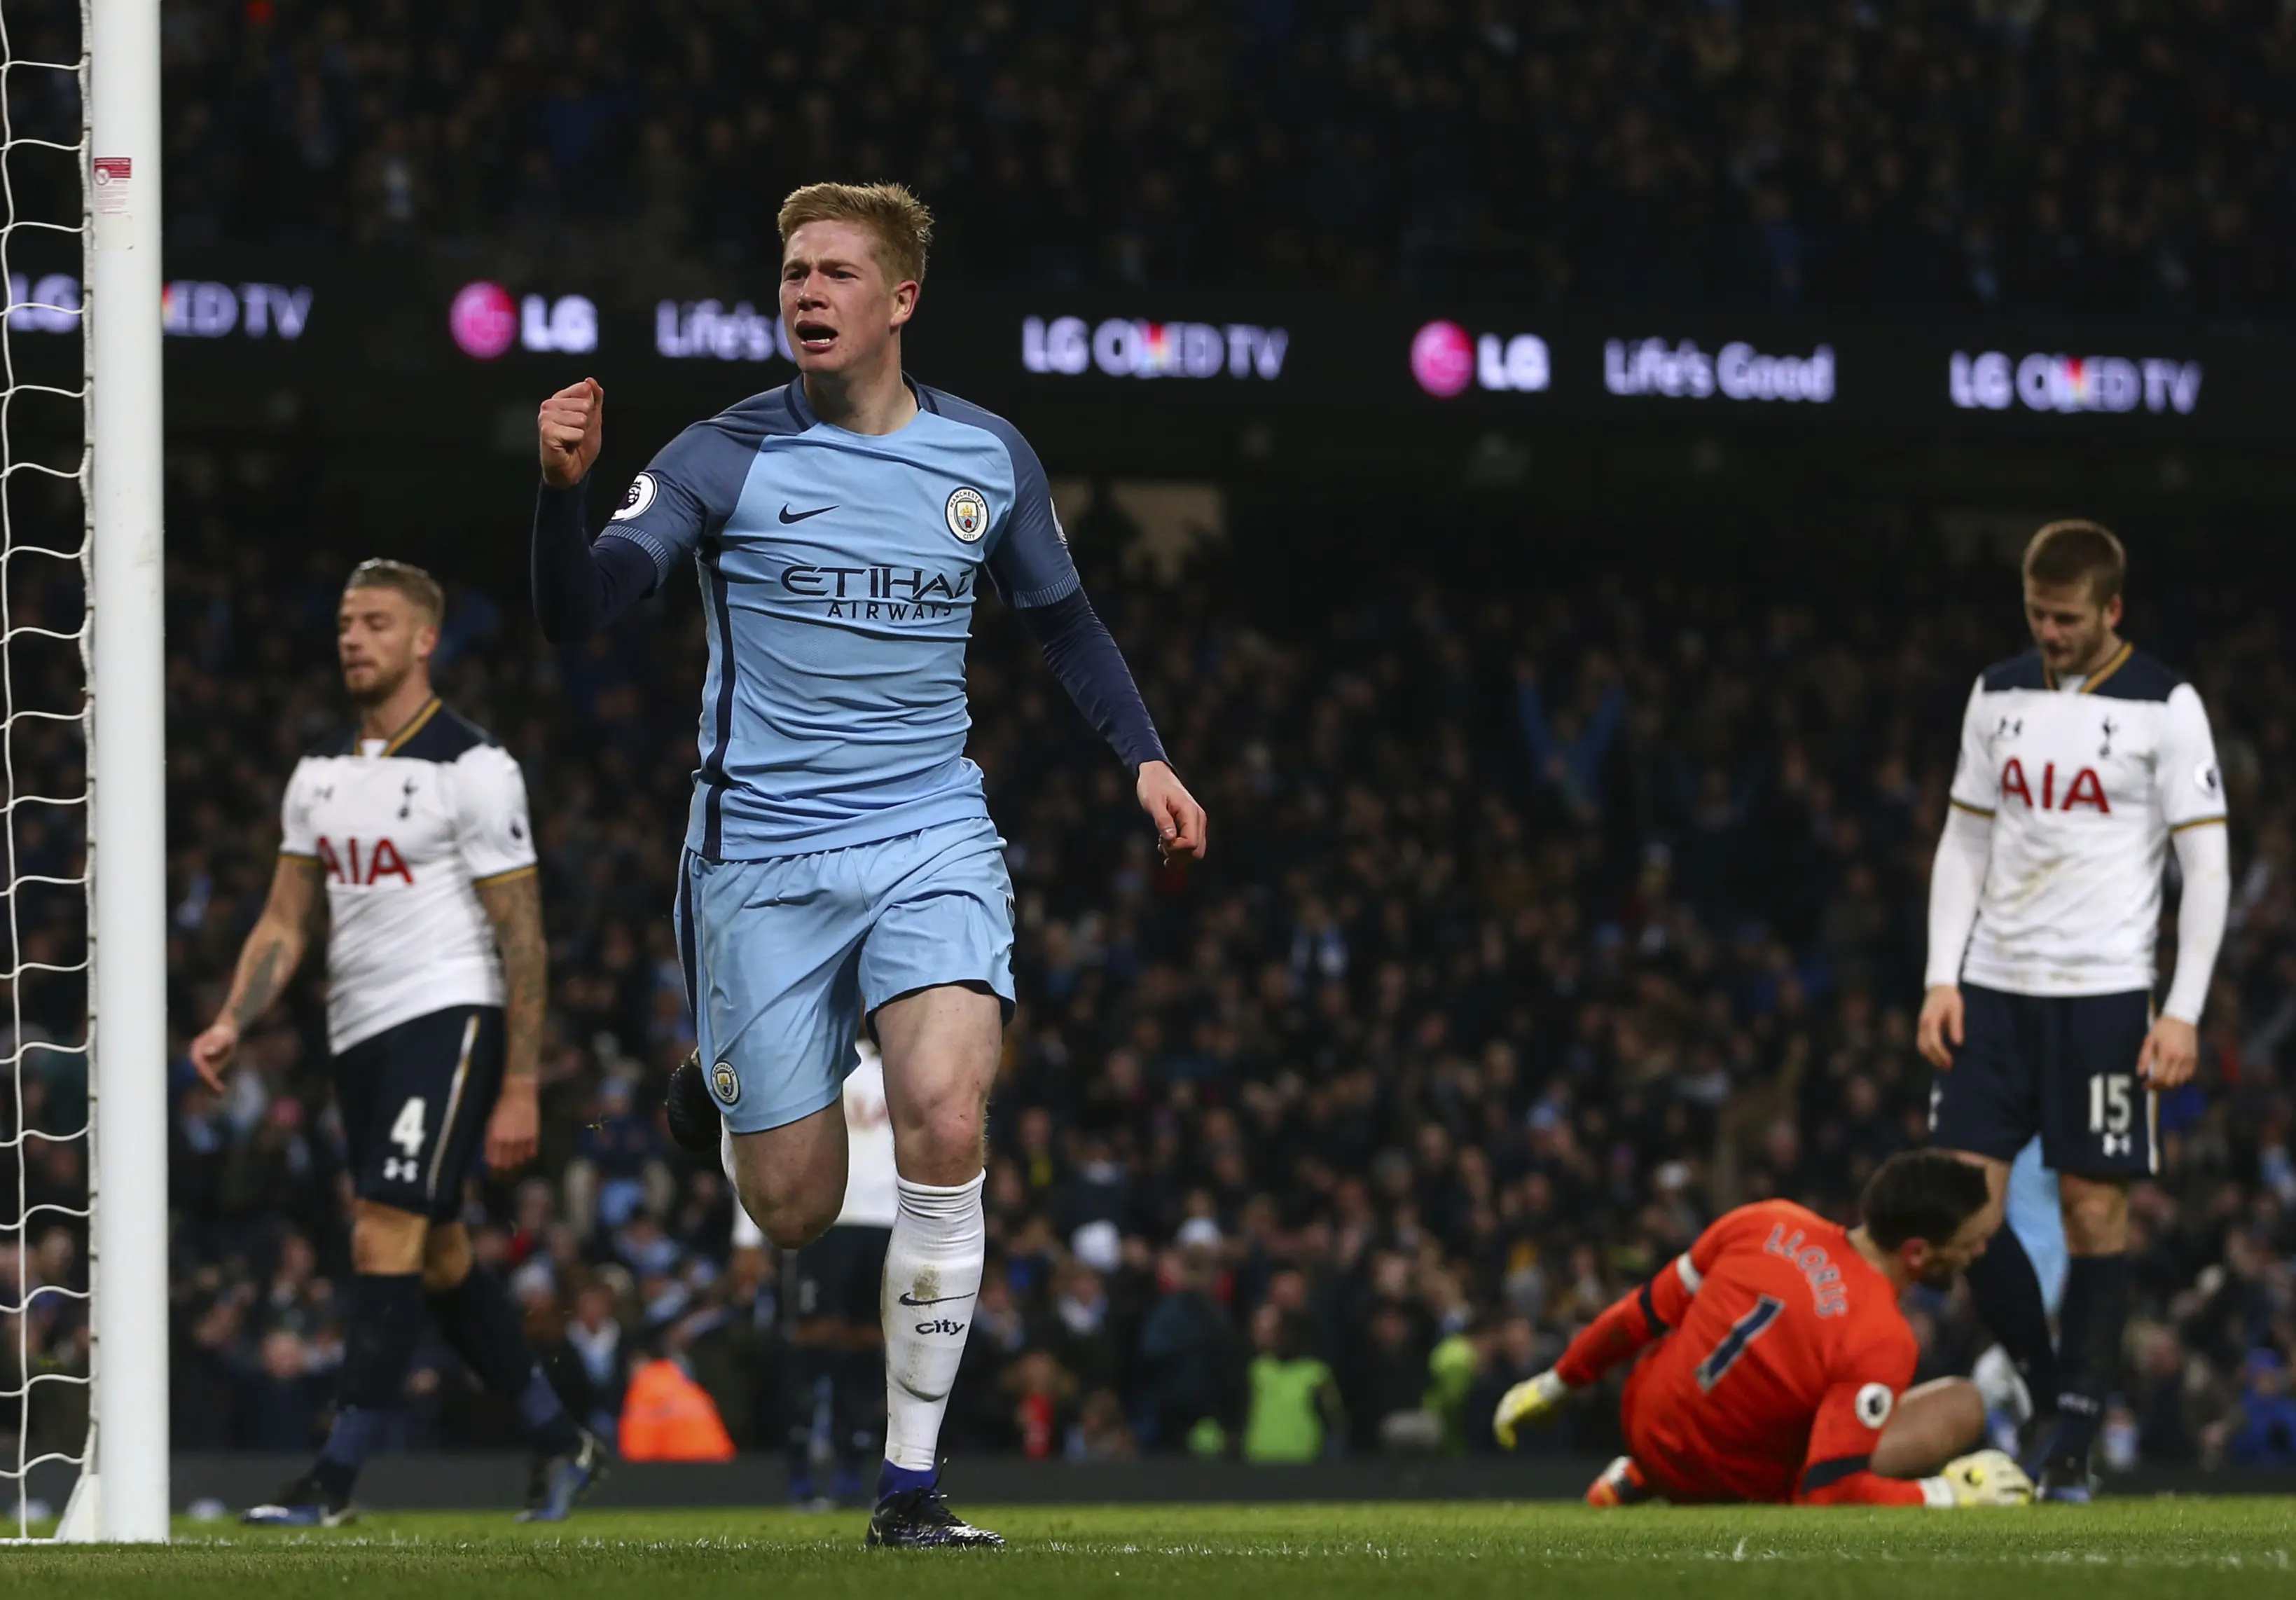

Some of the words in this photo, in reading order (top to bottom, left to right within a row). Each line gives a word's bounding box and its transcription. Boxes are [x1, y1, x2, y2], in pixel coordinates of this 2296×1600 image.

[8, 273, 81, 334] LG
[239, 283, 313, 339] TV
[520, 293, 599, 354] LG
[1022, 314, 1090, 375] LG
[1223, 323, 1289, 381] TV
[1477, 331, 1552, 393] LG
[1717, 340, 1837, 404] Good
[1949, 350, 2013, 411] LG
[2140, 357, 2203, 415] TV
[949, 491, 984, 509] MANCHESTER
[2000, 756, 2111, 814] AIA
[390, 1096, 427, 1157] 4
[2089, 1073, 2132, 1134] 15
[1762, 1222, 1849, 1320] LLORIS
[1693, 1292, 1786, 1395] 1
